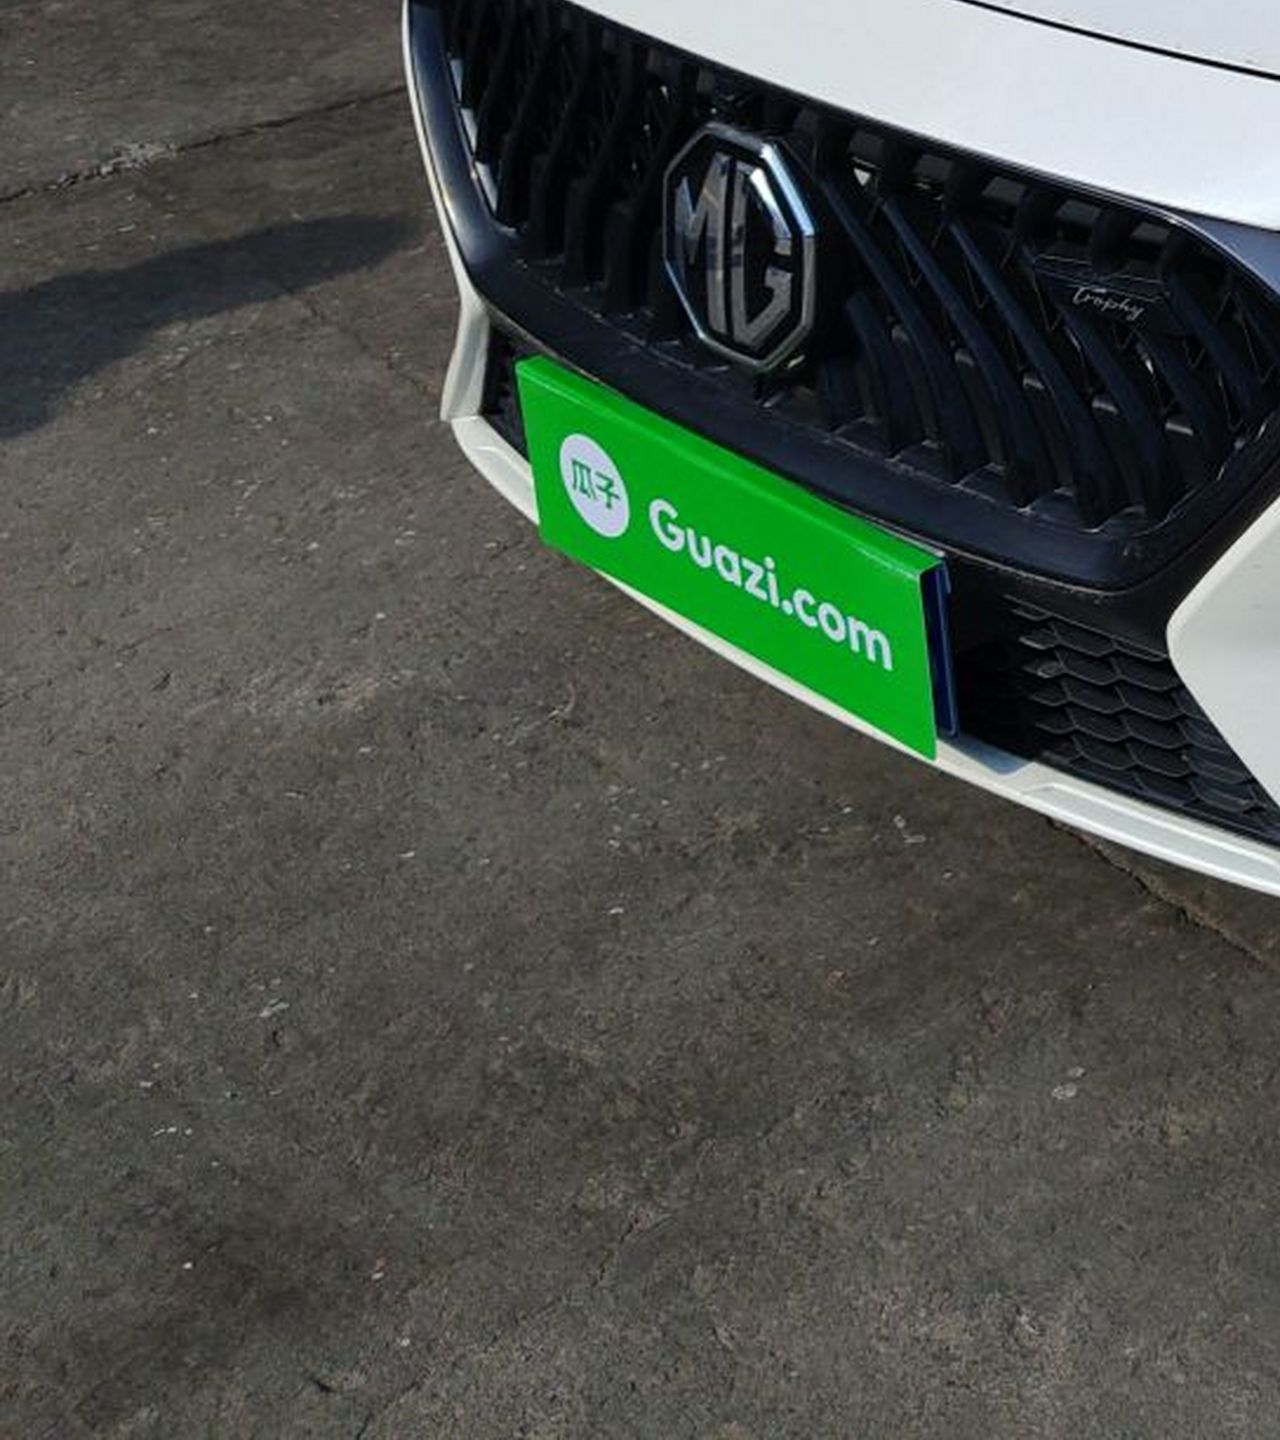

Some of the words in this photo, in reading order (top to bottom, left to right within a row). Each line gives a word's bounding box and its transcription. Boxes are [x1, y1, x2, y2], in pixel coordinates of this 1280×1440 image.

[674, 152, 794, 352] MG
[571, 458, 621, 509] 瓜子
[649, 498, 893, 671] Guazi.com
